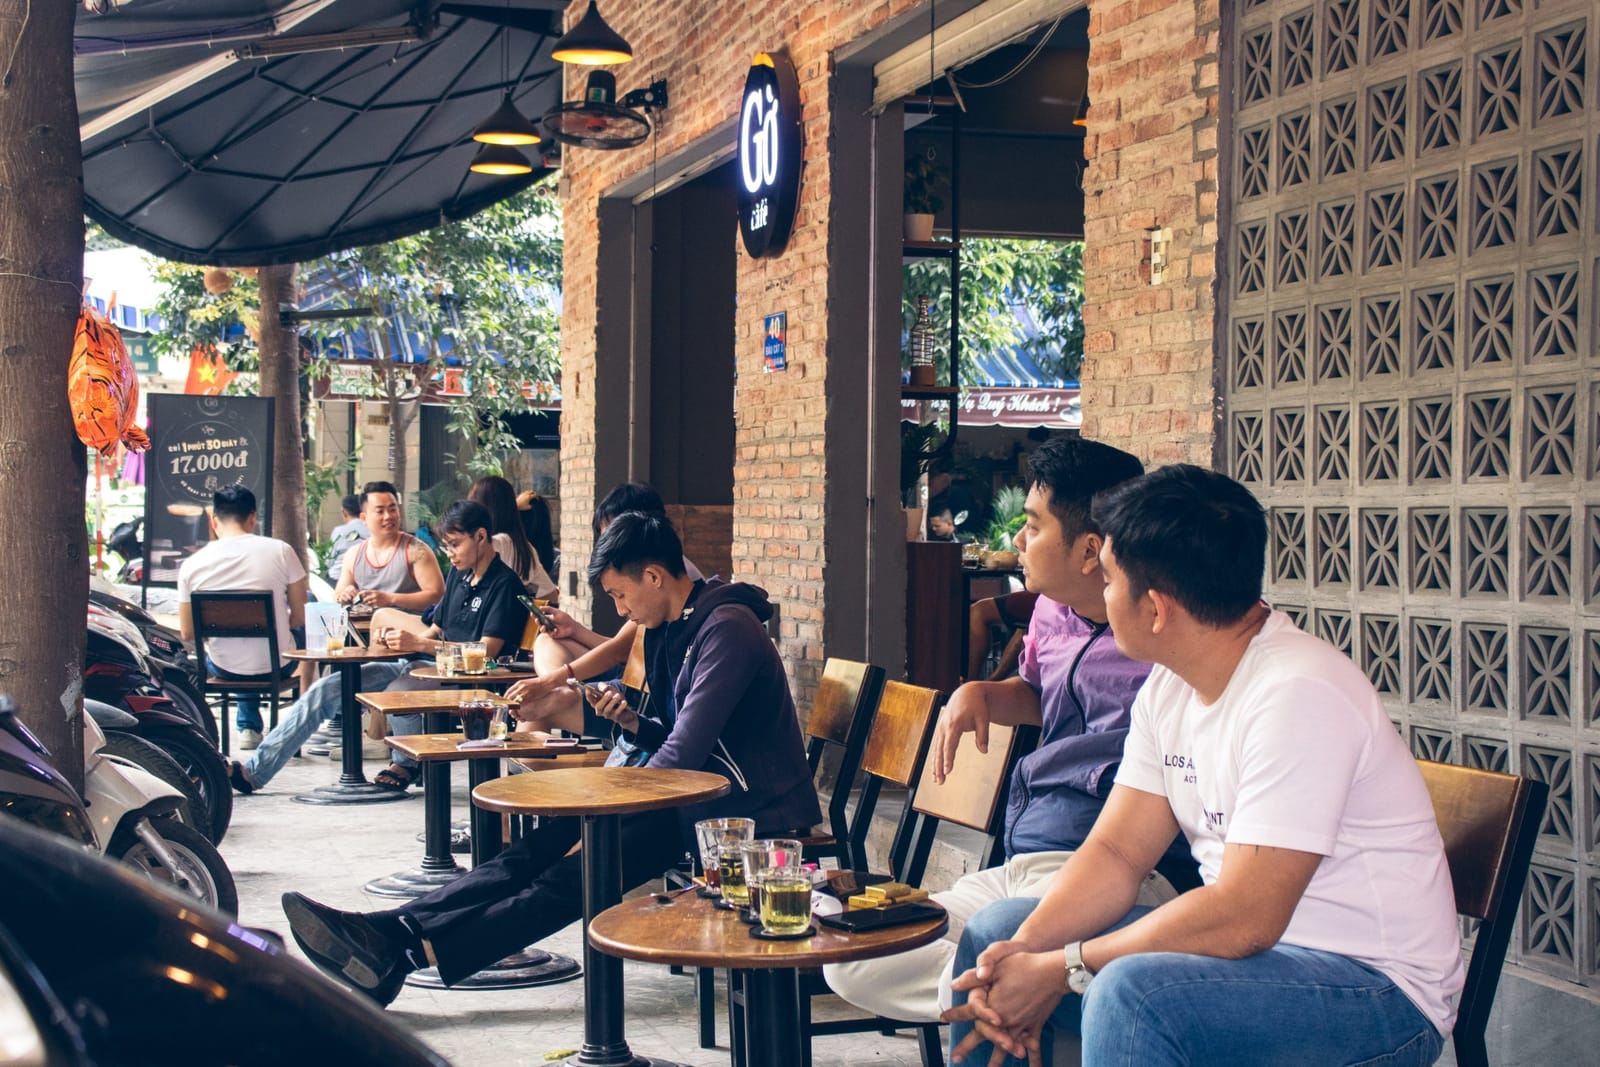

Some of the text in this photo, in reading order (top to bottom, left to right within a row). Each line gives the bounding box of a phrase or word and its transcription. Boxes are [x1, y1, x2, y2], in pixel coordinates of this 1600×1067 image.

[769, 317, 780, 339] 40
[977, 392, 1005, 417] Quý
[1007, 394, 1051, 412] Khách
[170, 450, 248, 474] 17.000đ
[1165, 754, 1185, 768] LOS
